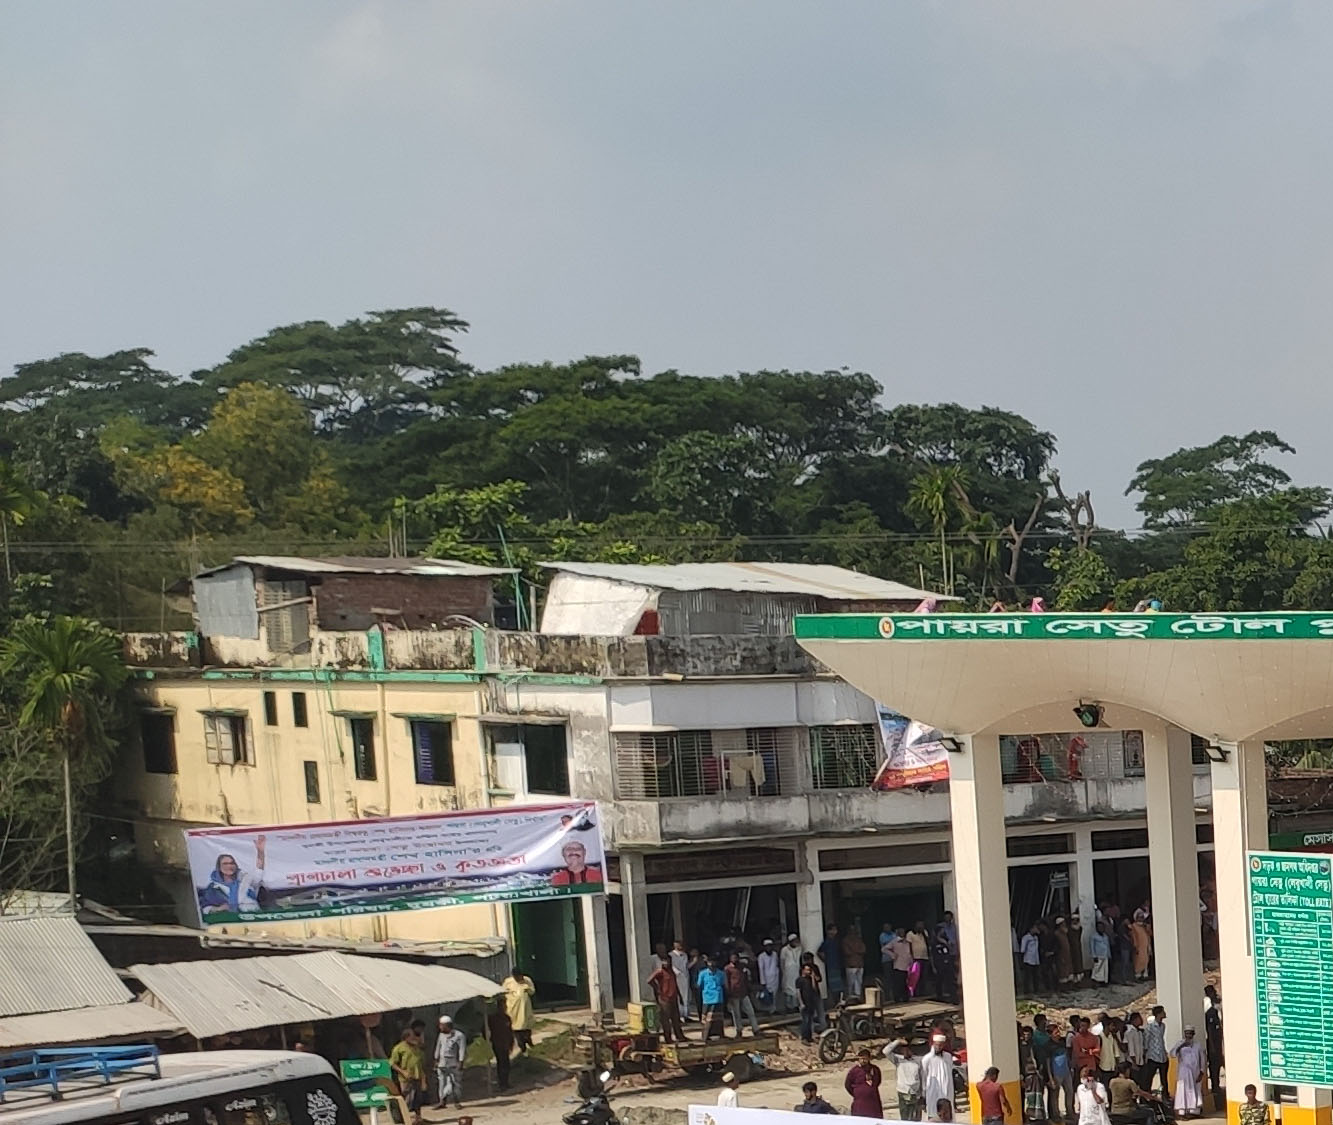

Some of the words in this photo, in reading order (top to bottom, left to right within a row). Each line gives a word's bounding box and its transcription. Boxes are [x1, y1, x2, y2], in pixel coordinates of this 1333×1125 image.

[897, 618, 1030, 635] পায়রা
[1046, 618, 1154, 639] সেতু
[1171, 615, 1295, 635] টোল
